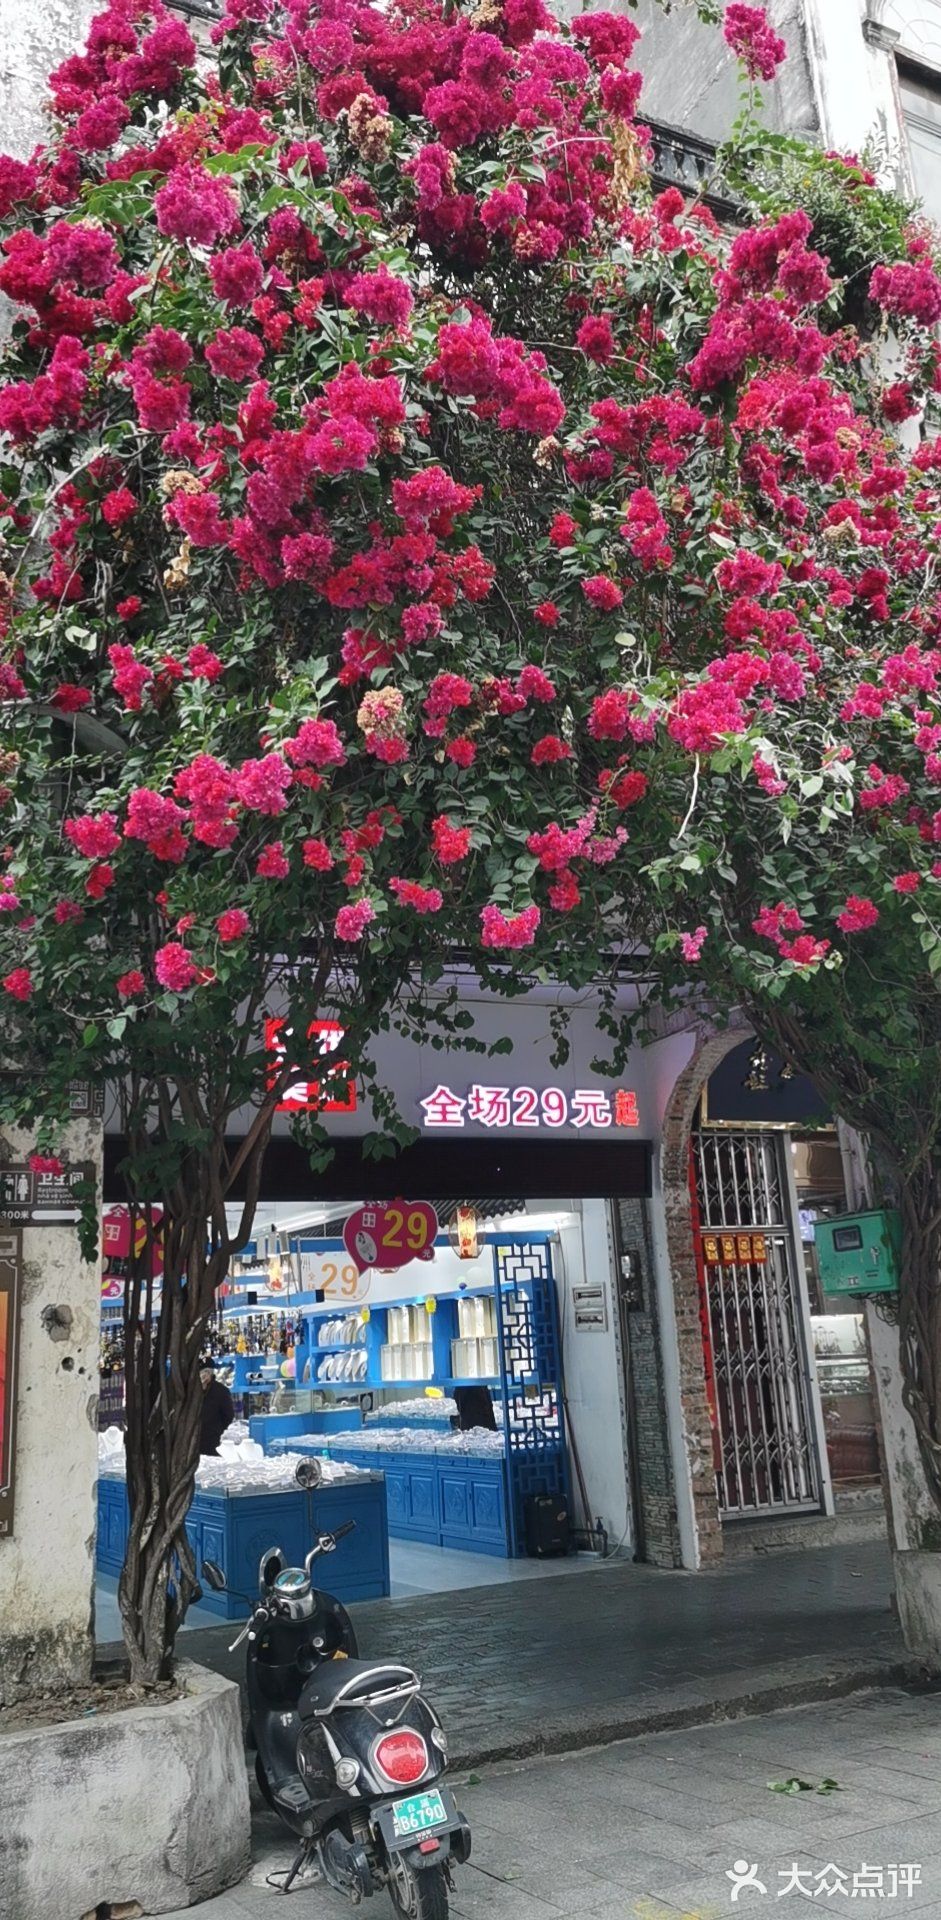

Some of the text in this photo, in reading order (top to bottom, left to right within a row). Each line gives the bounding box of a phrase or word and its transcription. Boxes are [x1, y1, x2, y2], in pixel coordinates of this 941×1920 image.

[420, 1085, 639, 1127] 全场29元起
[382, 1209, 428, 1249] 29
[321, 1263, 358, 1296] 29
[400, 1803, 444, 1831] B6790
